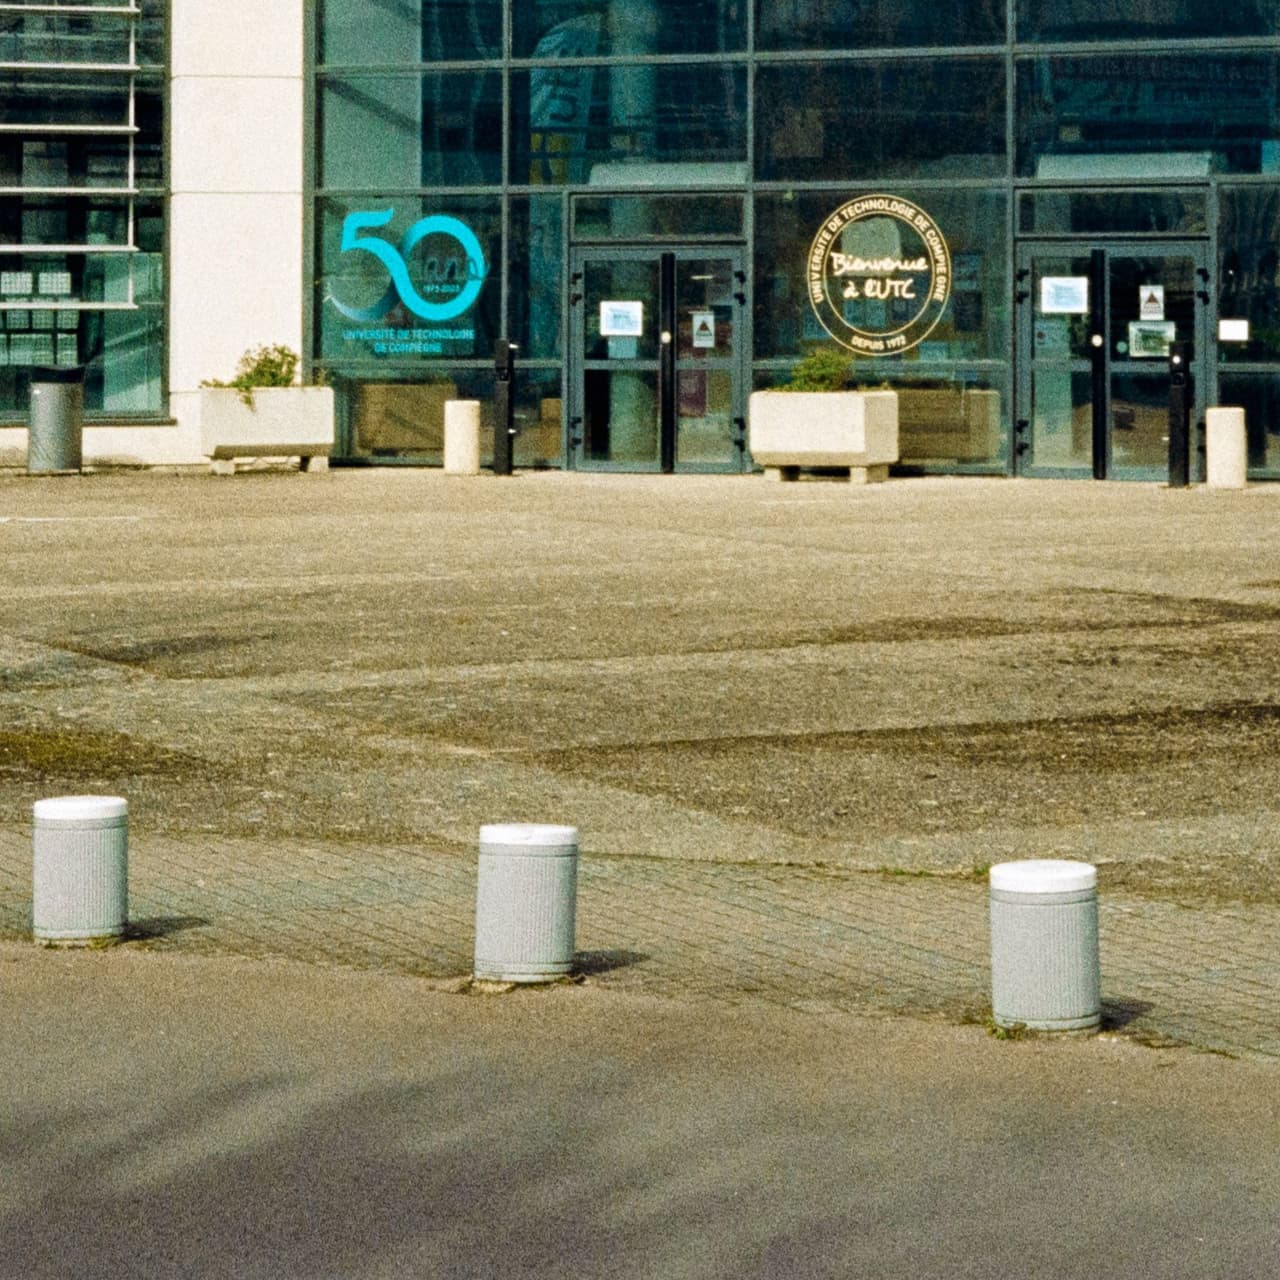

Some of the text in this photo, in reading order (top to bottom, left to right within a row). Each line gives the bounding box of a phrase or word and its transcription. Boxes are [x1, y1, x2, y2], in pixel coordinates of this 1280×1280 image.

[827, 215, 844, 233] DE
[841, 198, 917, 220] TECHNOLOGIE
[914, 214, 931, 233] DE
[330, 208, 485, 321] 50
[830, 251, 929, 276] Bienvenue
[397, 329, 410, 340] DE
[411, 328, 475, 340] TECHNOLOGIE
[851, 335, 885, 351] DEPUIS
